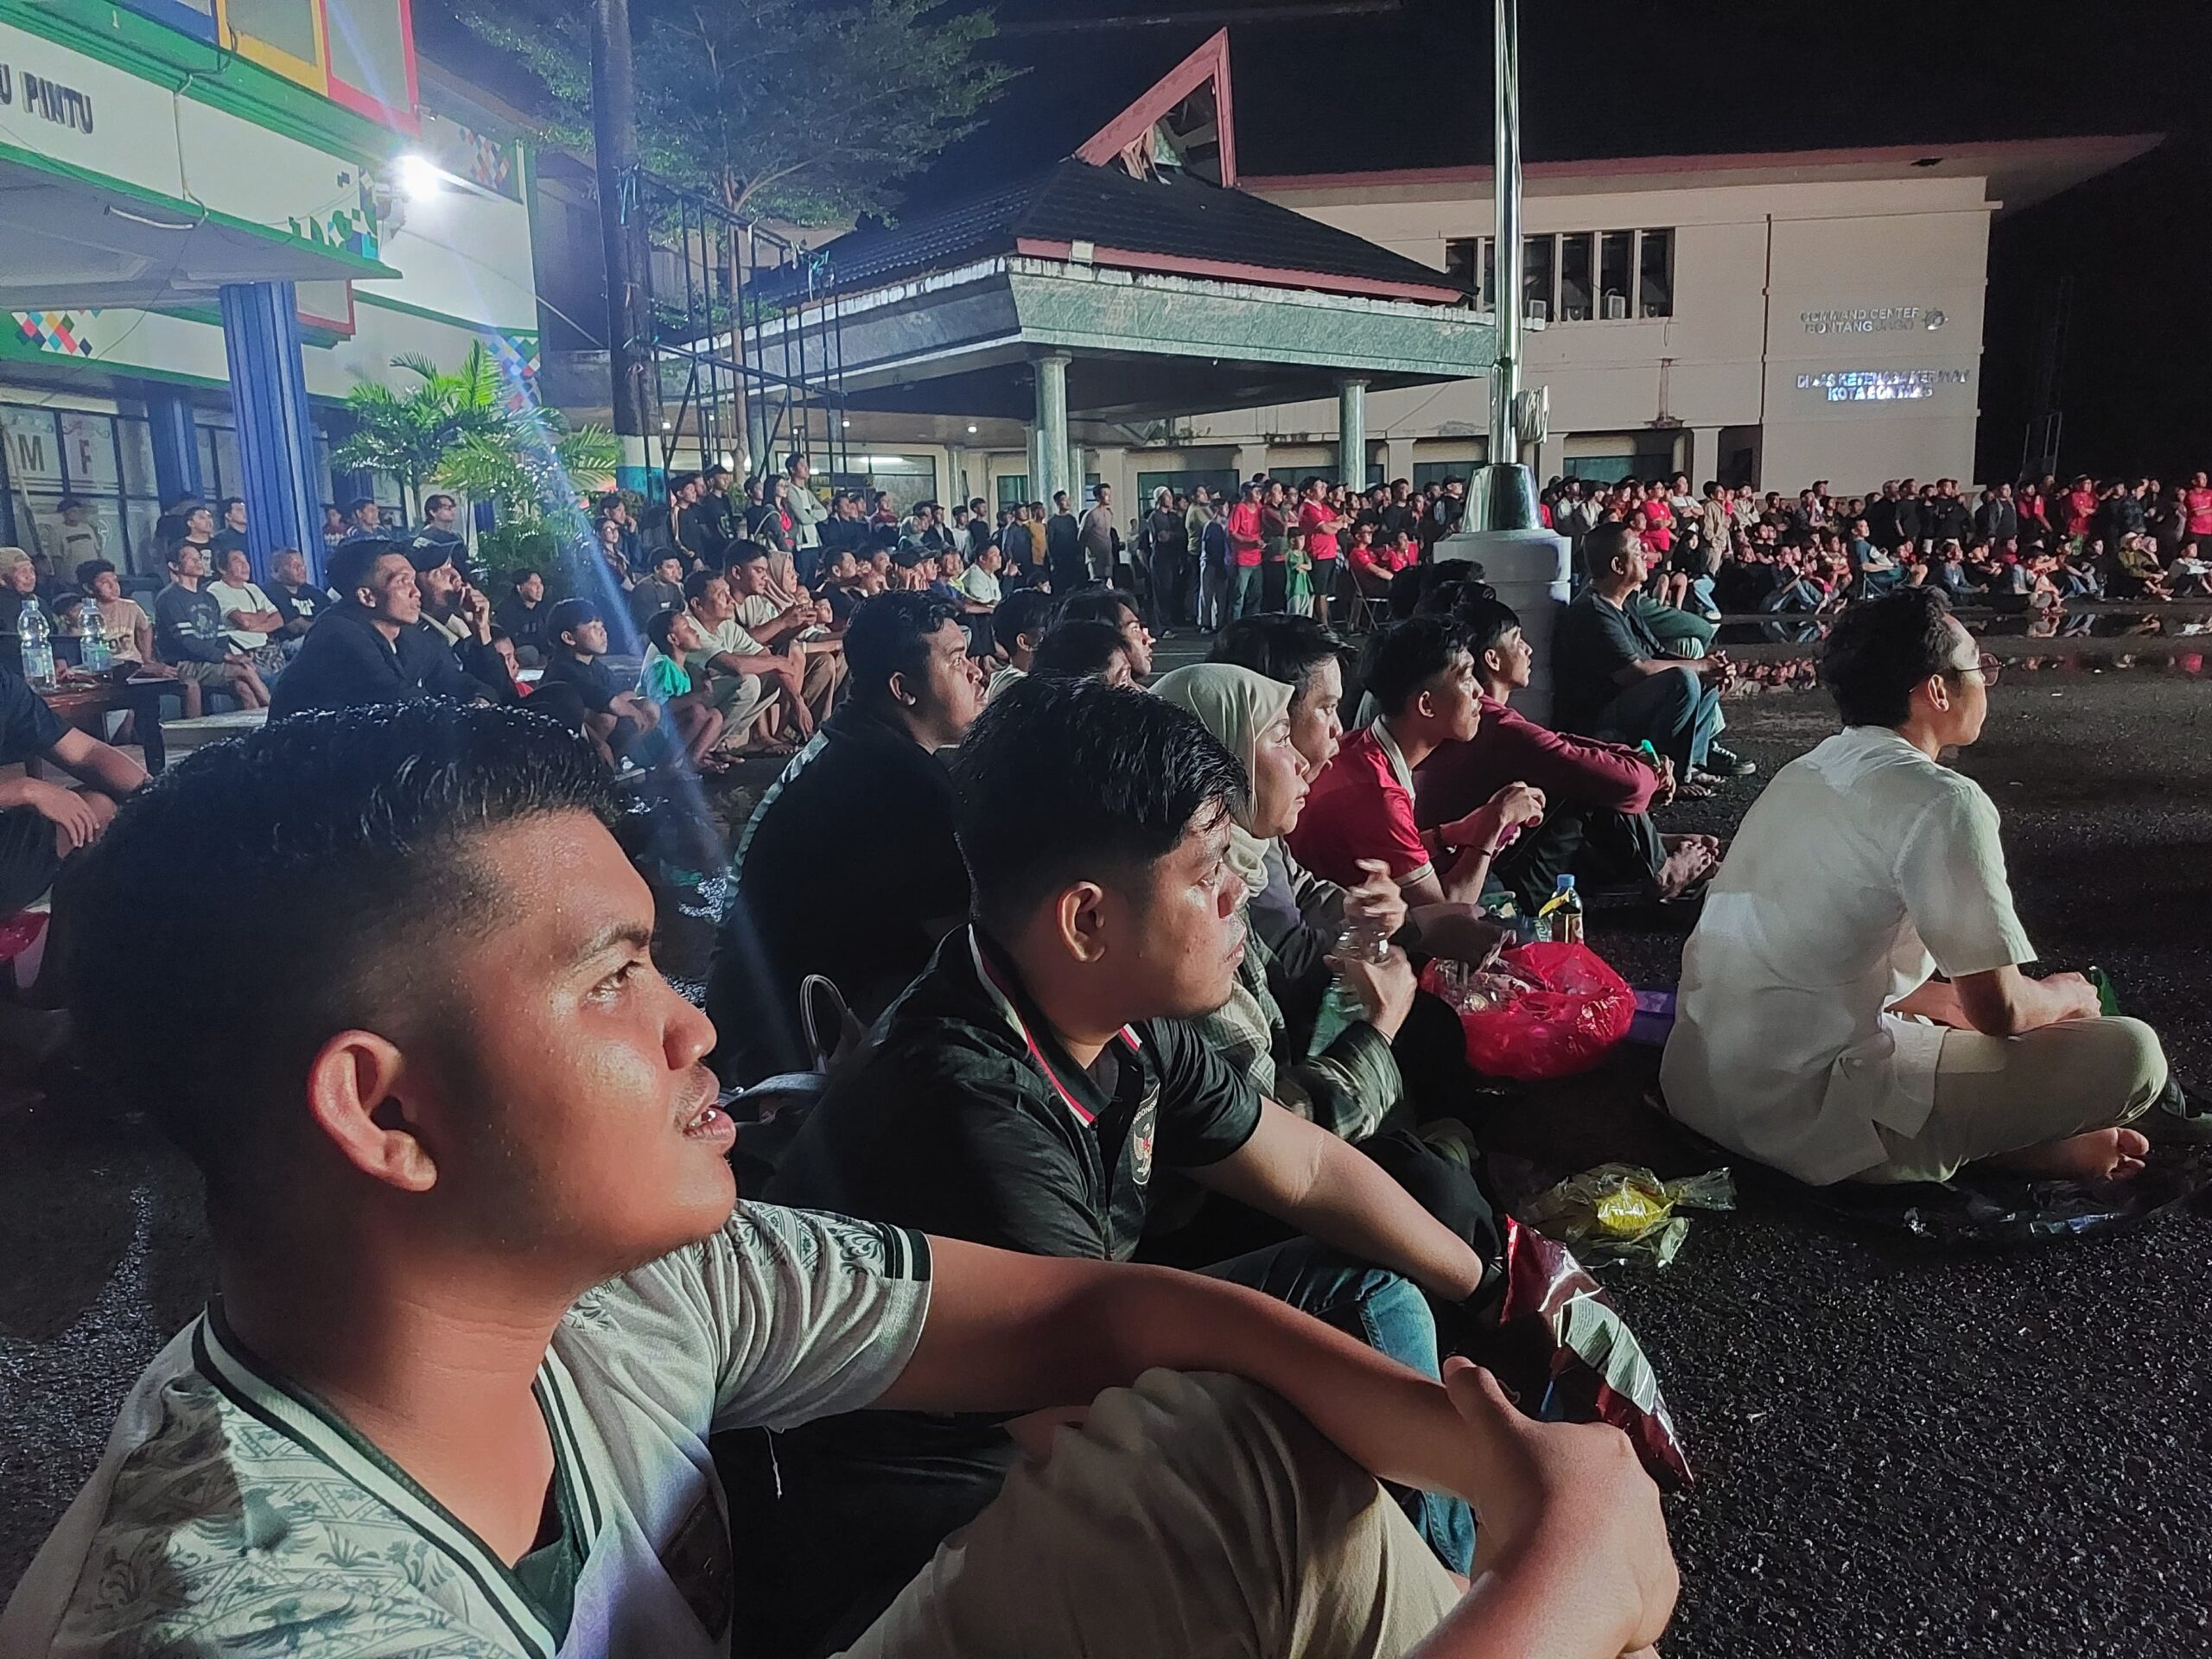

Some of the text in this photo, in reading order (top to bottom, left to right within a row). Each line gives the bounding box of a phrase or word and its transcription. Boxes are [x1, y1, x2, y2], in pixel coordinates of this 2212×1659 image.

[19, 71, 93, 134] PINTU
[1800, 307, 1920, 322] COMMAND CENTER
[1804, 321, 1873, 334] BONTANG
[1827, 387, 1866, 401] KOTA
[17, 434, 45, 472] M
